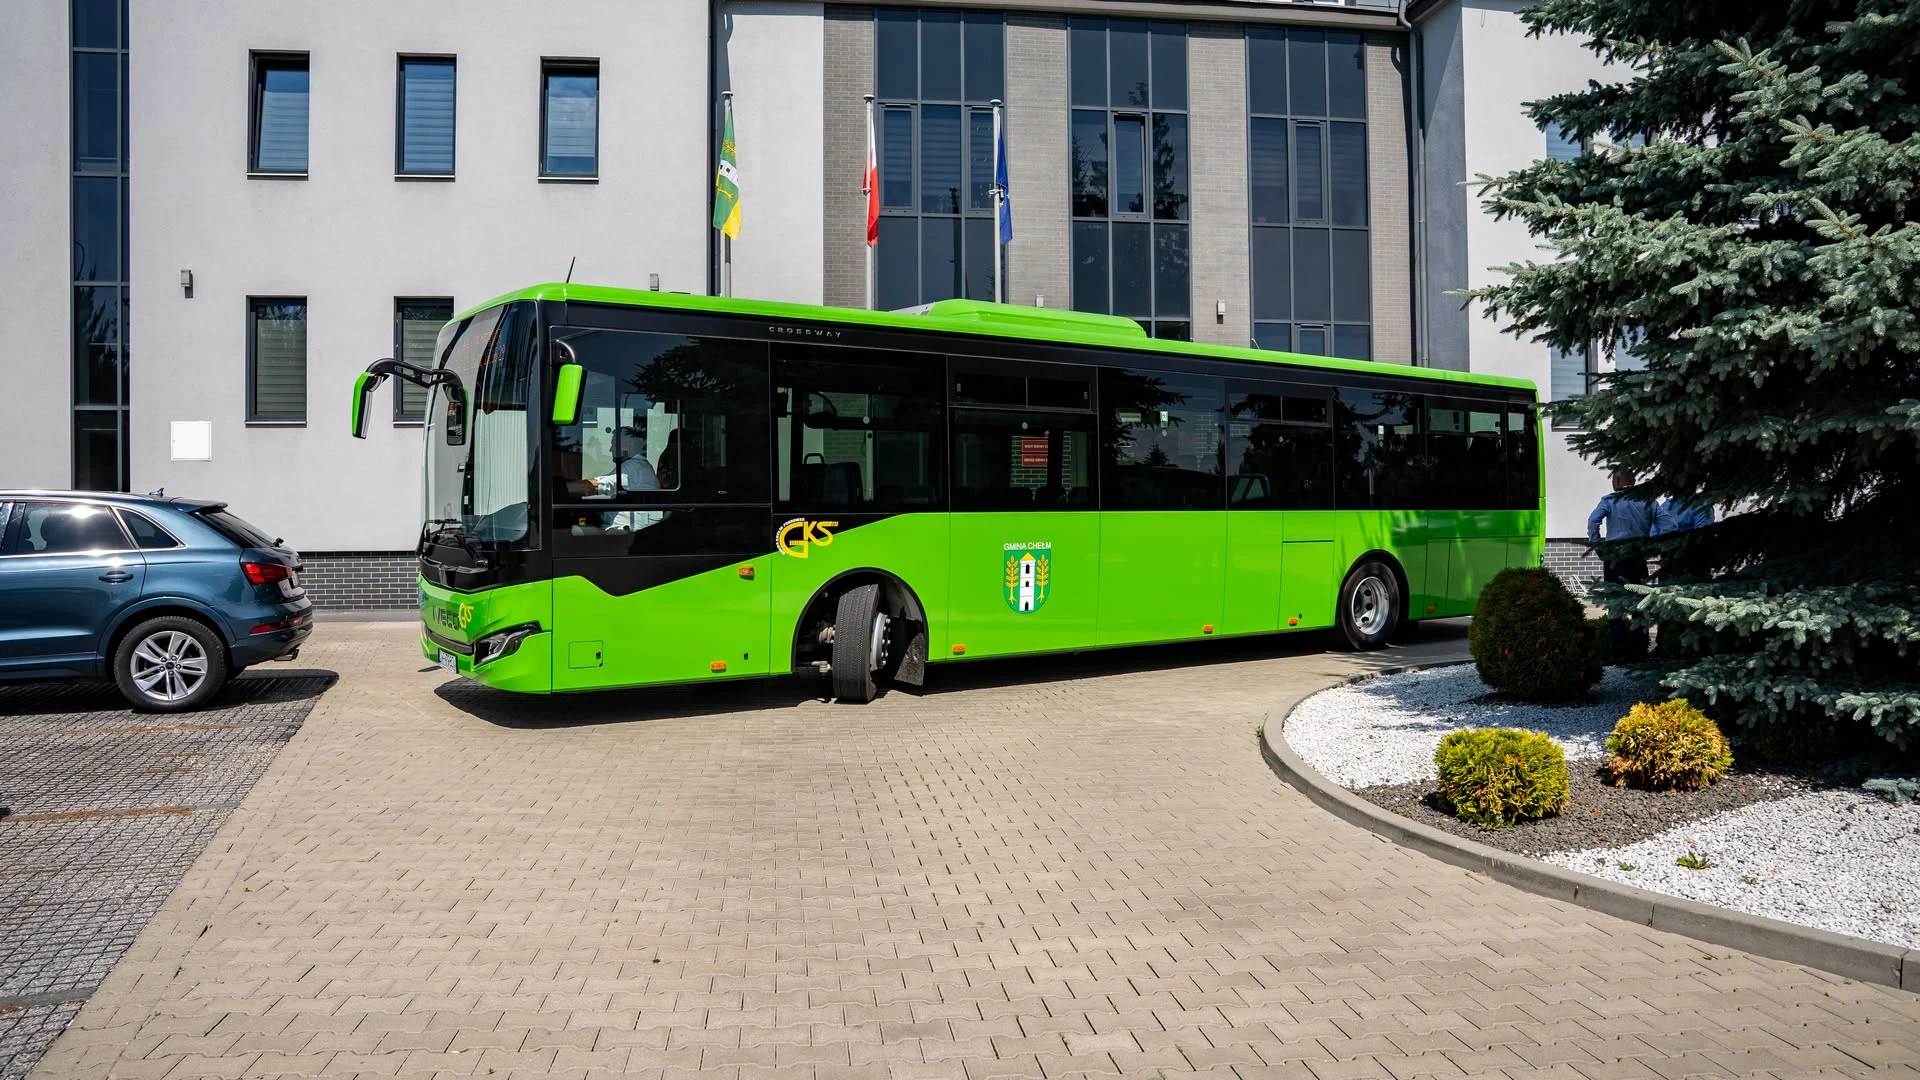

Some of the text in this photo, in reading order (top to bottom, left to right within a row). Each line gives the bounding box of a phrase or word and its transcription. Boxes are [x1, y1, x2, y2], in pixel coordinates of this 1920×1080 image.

[768, 326, 841, 338] CROSSWAY
[778, 520, 839, 559] GKS
[1003, 541, 1052, 551] GMINA CHEŁM
